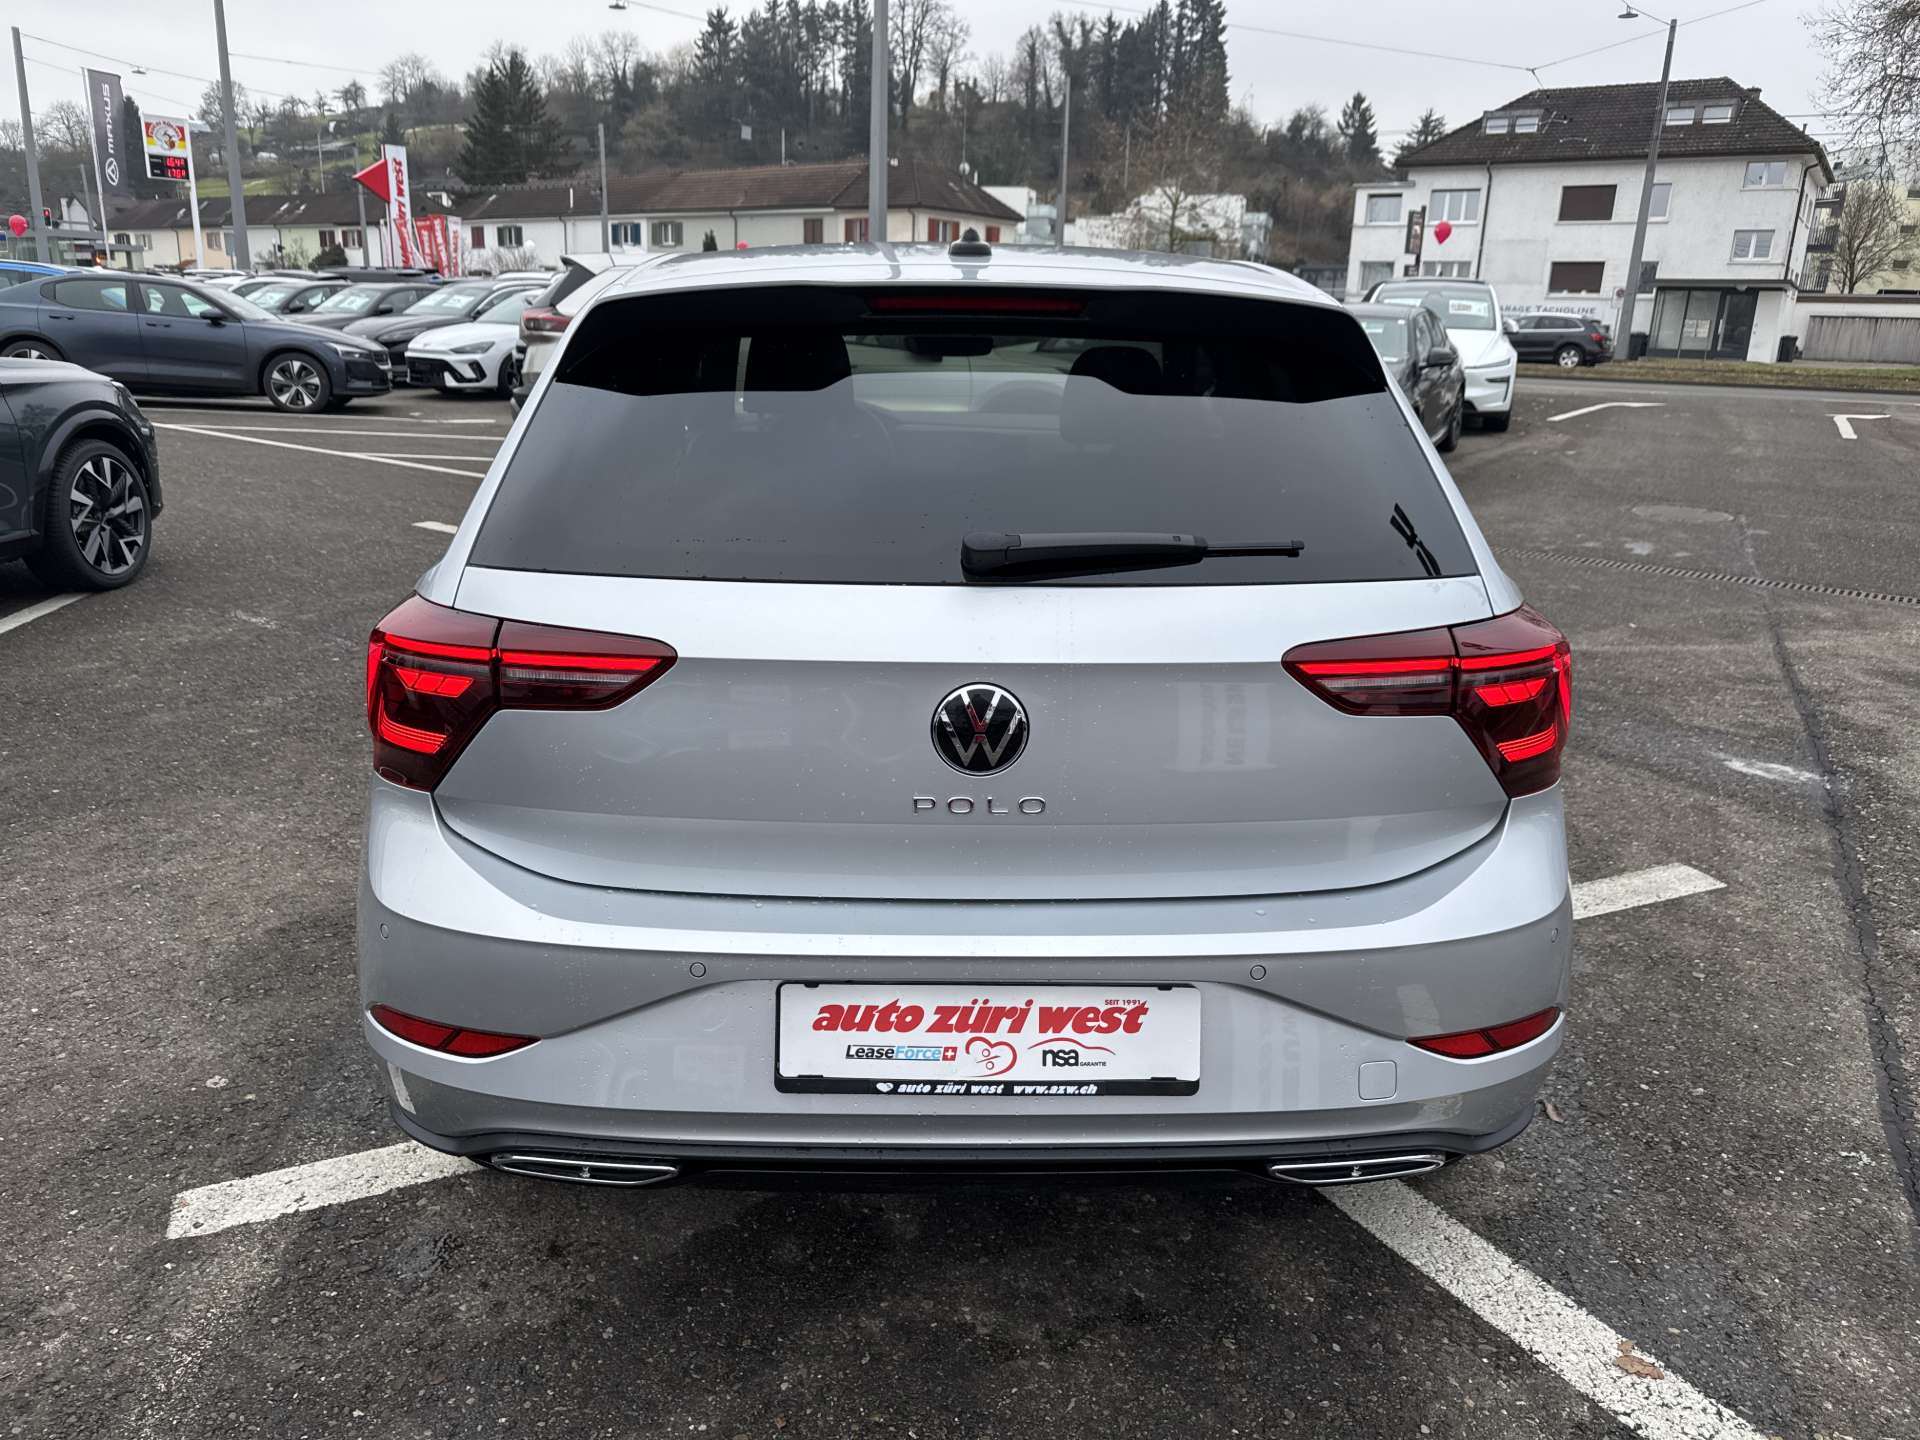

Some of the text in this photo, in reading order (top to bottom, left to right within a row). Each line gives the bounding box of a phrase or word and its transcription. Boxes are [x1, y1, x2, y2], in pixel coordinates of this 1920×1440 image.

[1500, 303, 1597, 315] ARAGE TACHOLINE
[933, 685, 1028, 773] VW
[912, 796, 1047, 815] POLO
[812, 998, 1150, 1035] auto züri west
[845, 1045, 942, 1059] LeaseForce
[1042, 1049, 1079, 1067] nsa
[897, 1082, 1098, 1095] auto züri west www.azw.ch
